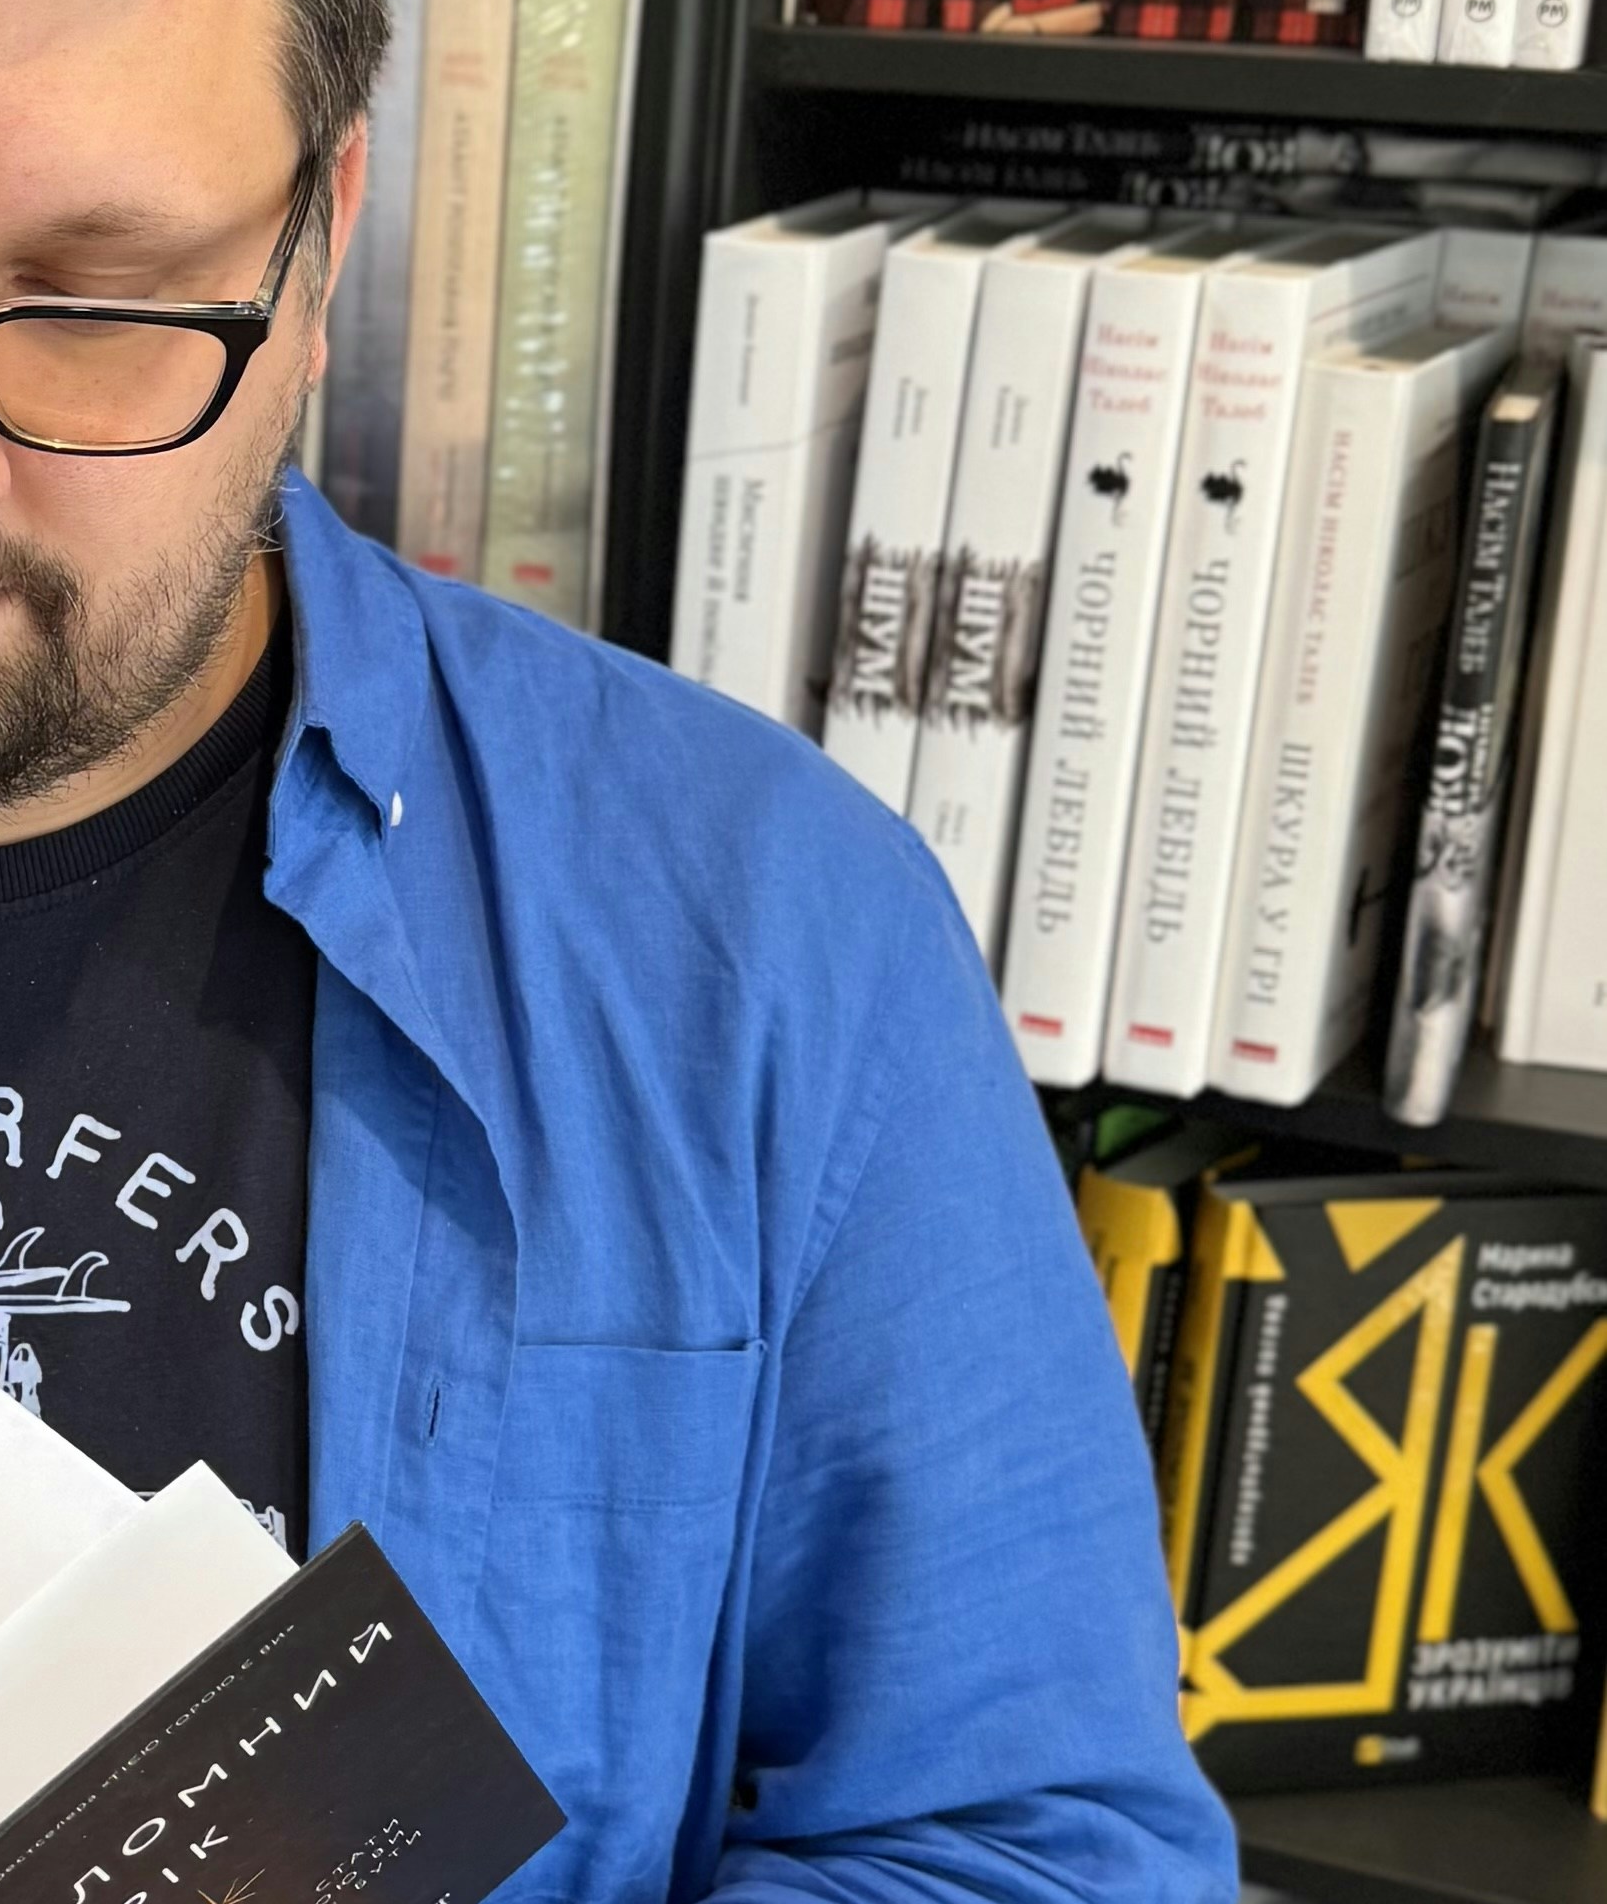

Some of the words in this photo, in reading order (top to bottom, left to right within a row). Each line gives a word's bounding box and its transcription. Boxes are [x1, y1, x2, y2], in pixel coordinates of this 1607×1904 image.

[1322, 431, 1353, 509] НАСІМ
[706, 476, 730, 569] швидке
[734, 479, 762, 602] Мислення
[1306, 517, 1343, 621] НІКОЛАС
[852, 565, 907, 696] ШУМ
[949, 576, 1004, 705] ШУМ
[1059, 549, 1117, 740] ЧОРНИЙ
[1170, 559, 1228, 752] ЧОРНИЙ
[1296, 631, 1327, 705] ТАЛЕБ
[1037, 757, 1091, 933] ЛЕБІДЬ
[1147, 766, 1202, 944] ЛЕБІДЬ
[1261, 743, 1315, 888] ШКУРА
[1257, 906, 1290, 934] У
[1246, 947, 1283, 1006] ГРІ
[1478, 1242, 1573, 1275] Марина
[166, 1675, 235, 1734] ГОРОЮ
[316, 1819, 398, 1891] СТАТИ
[355, 1831, 421, 1890] БУТИ
[372, 1831, 403, 1858] ВИ
